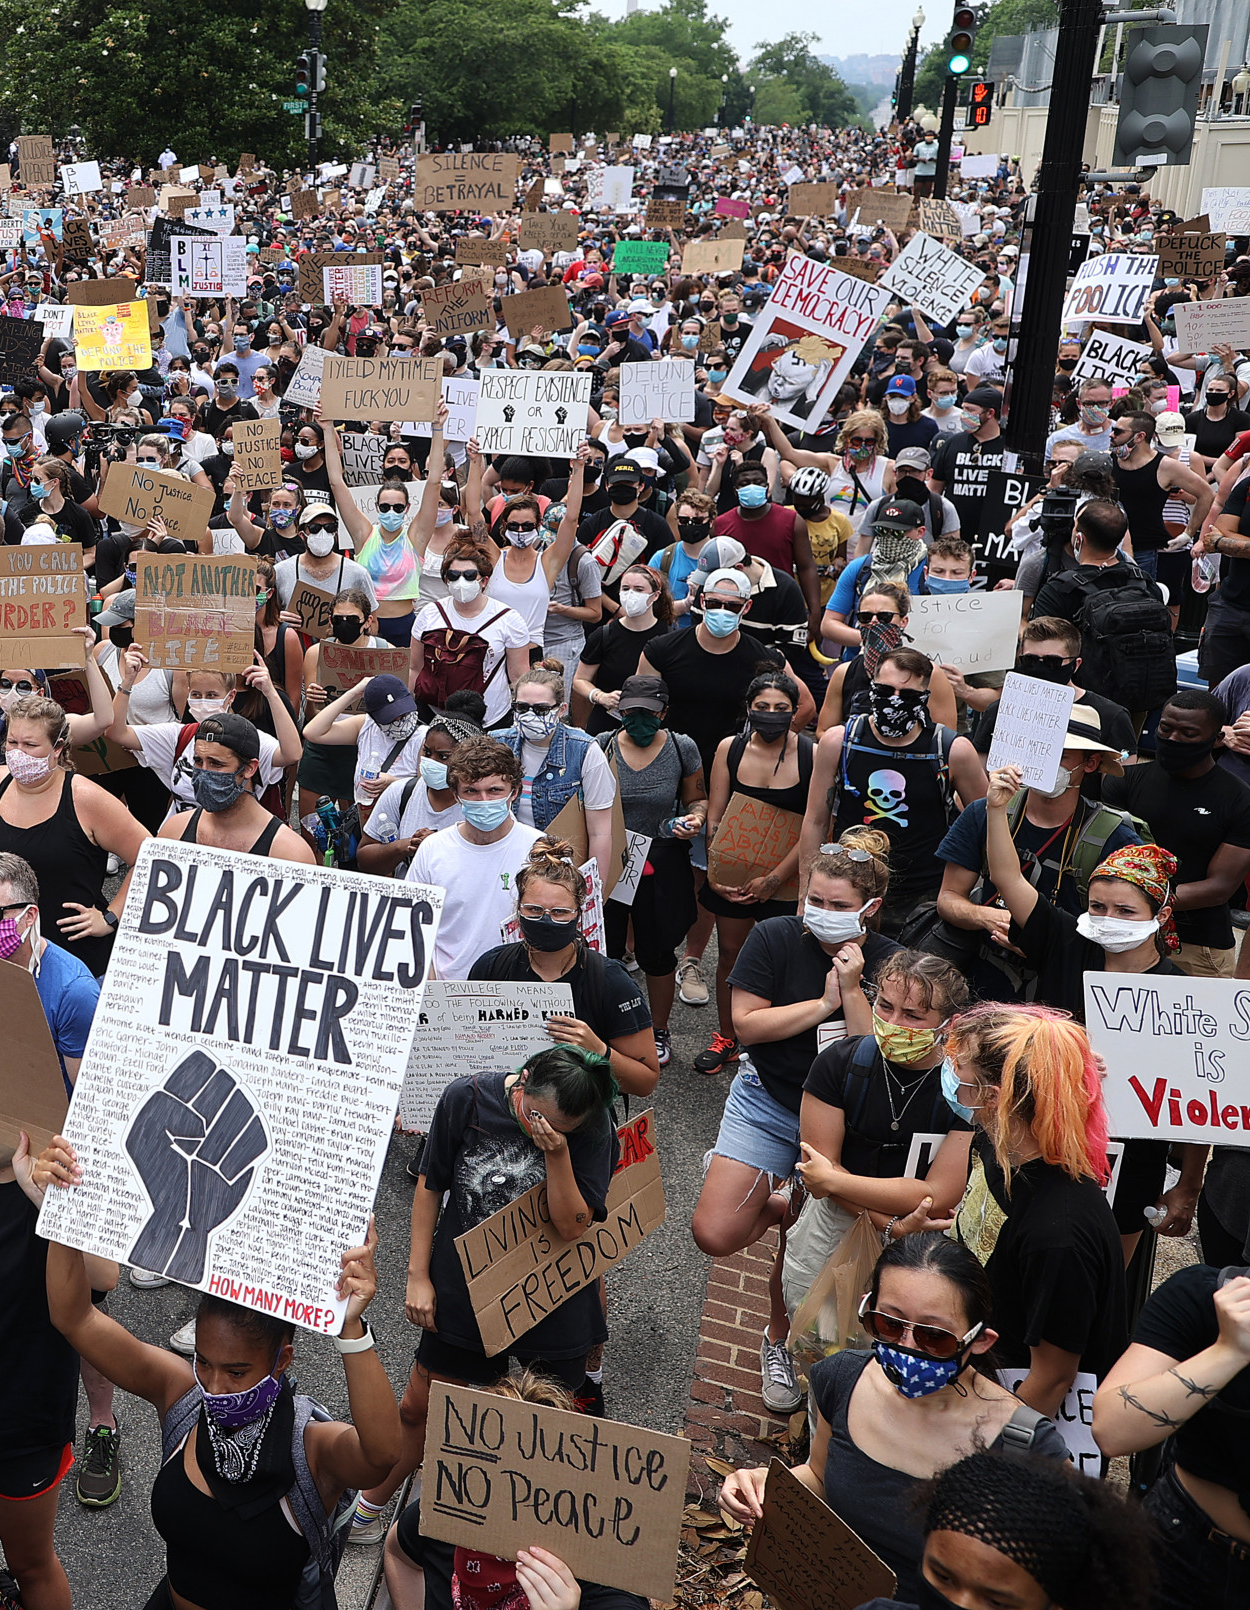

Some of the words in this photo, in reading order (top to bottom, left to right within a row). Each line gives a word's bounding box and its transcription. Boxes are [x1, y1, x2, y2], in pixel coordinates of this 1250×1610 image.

[433, 154, 505, 173] SILENCE
[424, 182, 510, 205] BETRAYAL
[525, 217, 545, 230] TAKE
[550, 219, 569, 231] YOUR
[1158, 234, 1222, 250] DEFUCK
[918, 238, 976, 290] WHITE
[1176, 251, 1201, 260] THE
[472, 268, 485, 276] NO
[900, 256, 967, 304] SILENCE
[1160, 259, 1224, 277] POLICE
[422, 280, 484, 306] REFORM
[784, 254, 837, 296] SAVE
[835, 277, 881, 316] OUR
[440, 296, 470, 317] THE
[891, 275, 952, 320] VIOLENCE
[1071, 284, 1151, 320] POOLICE
[772, 279, 876, 343] DEMOCRACY!
[81, 345, 122, 357] DEFUND
[125, 344, 146, 354] THE
[99, 356, 134, 367] POLICE
[1086, 339, 1142, 372] BLACK
[622, 361, 694, 386] DEFUND
[482, 374, 530, 400] RESPECT
[534, 376, 590, 404] EXISTENCE
[641, 382, 669, 393] THE
[527, 406, 543, 418] OR
[621, 392, 693, 423] POLICE
[246, 424, 265, 438] NO
[343, 434, 386, 452] BLACK
[476, 426, 514, 451] EXPECT
[521, 426, 586, 454] RESISTANCE
[237, 436, 281, 455] JUSTICE
[247, 456, 266, 469] NO
[955, 452, 1002, 466] BLACK
[238, 471, 279, 489] PEACE
[125, 497, 148, 521] No
[7, 552, 34, 572] YOU
[39, 551, 79, 571] CALL
[0, 577, 28, 598] THE
[32, 576, 79, 595] POLICE
[143, 563, 187, 598] NOT
[191, 564, 256, 598] ANOTHER
[148, 638, 221, 668] LIFE
[1006, 676, 1023, 691] BLACK
[1023, 681, 1040, 695] LIVES
[1040, 686, 1068, 703] MATTER
[139, 858, 307, 964] BLACK
[309, 884, 435, 989] LIVES
[444, 983, 502, 995] PRIVILEGE
[158, 949, 360, 1065] MATTER
[426, 1000, 441, 1008] DO
[445, 999, 463, 1008] THE
[470, 999, 525, 1009] FOLLOWING
[531, 998, 574, 1009] WITHOUT
[1090, 985, 1218, 1038] White
[437, 1012, 446, 1022] of
[452, 1012, 475, 1024] being
[478, 1008, 529, 1022] HARMED
[1194, 1042, 1226, 1083] is
[500, 1201, 645, 1340] FREEDOM
[209, 1274, 243, 1300] HOW
[243, 1286, 283, 1313] MANY
[284, 1299, 335, 1333] MORE?
[443, 1394, 505, 1451] NO
[518, 1413, 669, 1492] Justice
[436, 1460, 492, 1508] NO
[502, 1469, 641, 1546] Peace
